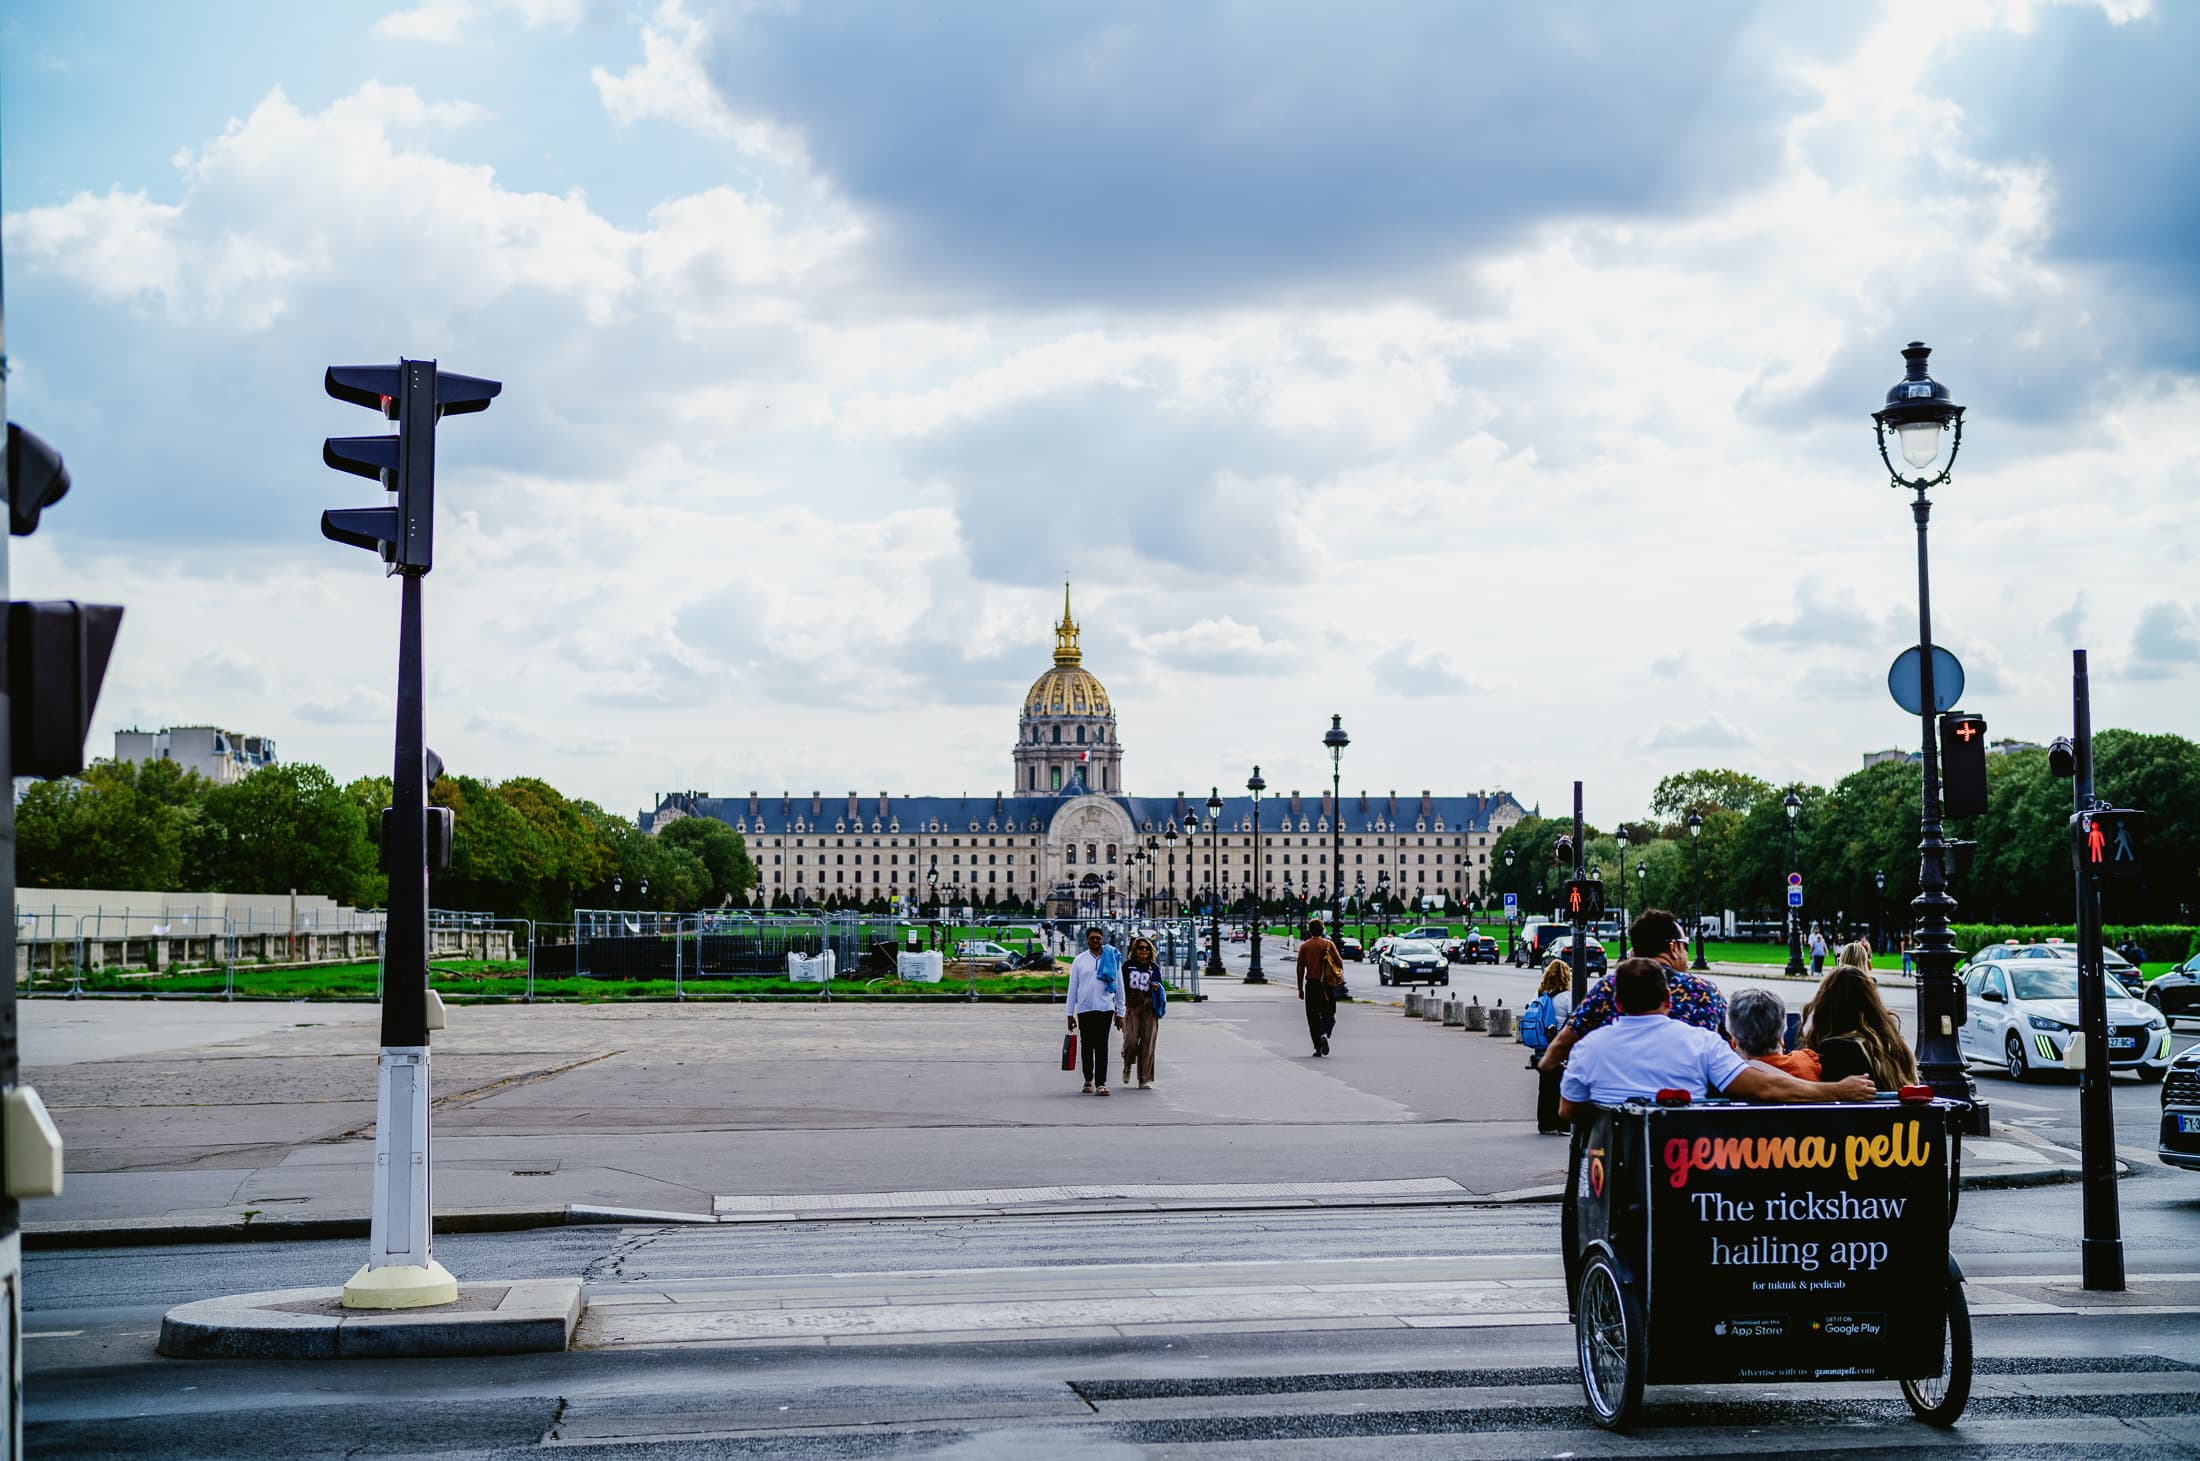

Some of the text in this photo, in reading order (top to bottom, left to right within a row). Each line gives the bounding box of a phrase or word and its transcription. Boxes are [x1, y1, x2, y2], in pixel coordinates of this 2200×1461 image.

[1129, 970, 1150, 992] 89
[1664, 1119, 1931, 1188] gemma pell
[1691, 1190, 1907, 1222] The rickshaw
[1711, 1235, 1889, 1272] hailing app
[1752, 1279, 1846, 1291] for tuktuk & pedicab
[1731, 1325, 1783, 1337] App Store
[1824, 1322, 1881, 1336] Google Play
[1738, 1368, 1777, 1377] Advertise
[1779, 1368, 1797, 1376] with
[1814, 1366, 1875, 1378] gemmapell.com
